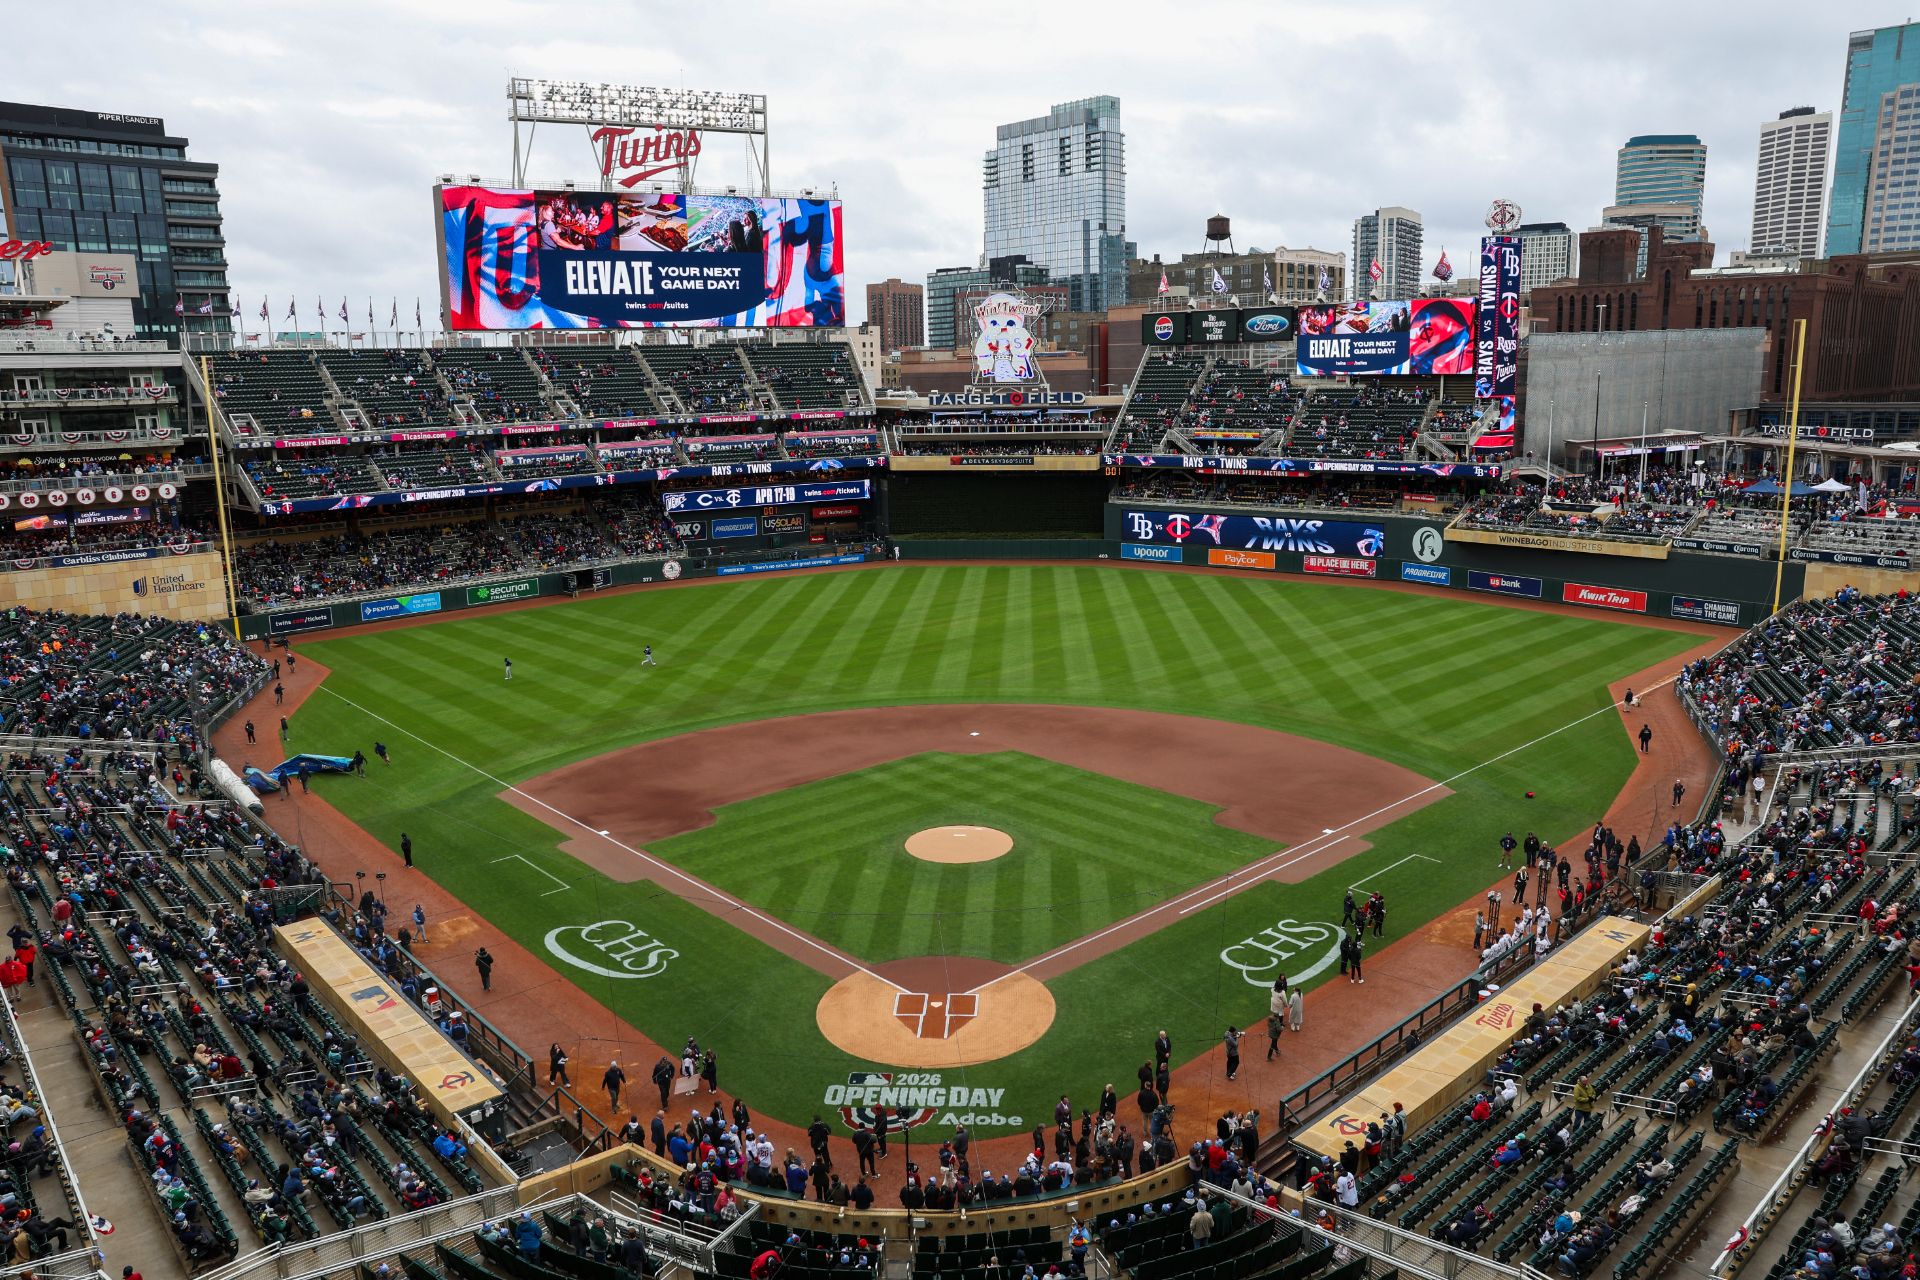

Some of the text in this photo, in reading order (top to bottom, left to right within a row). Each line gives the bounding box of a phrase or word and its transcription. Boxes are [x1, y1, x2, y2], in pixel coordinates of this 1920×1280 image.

[98, 113, 159, 125] PIPER SANDLER
[592, 124, 702, 178] Twins
[1502, 247, 1519, 277] TB
[658, 267, 741, 277] YOUR NEXT
[565, 260, 655, 296] ELEVATE
[661, 280, 740, 290] GAME DAY!
[1481, 265, 1497, 311] TWINS
[625, 302, 689, 310] twins.com/suites
[975, 301, 1039, 317] Win! Twins!
[1202, 320, 1226, 328] Minnesota
[1254, 319, 1279, 332] Ford
[1309, 339, 1350, 358] ELEVATE
[1478, 340, 1494, 375] RAYS
[1496, 363, 1516, 380] Twins
[929, 392, 1085, 405] TARGET FIELD
[507, 425, 554, 434] Treasure Island
[1830, 427, 1873, 438] FIELD
[318, 438, 340, 446] Island
[851, 435, 869, 443] Deck
[653, 445, 671, 454] Deck
[34, 456, 65, 465] Surfside
[1183, 457, 1203, 468] RAYS
[1220, 458, 1247, 469] TWINS
[711, 465, 731, 476] RAYS
[747, 463, 771, 474] TWINS
[1324, 463, 1374, 472] OPENING DAY 2026
[111, 491, 116, 499] 6
[415, 492, 440, 501] OPENING
[440, 490, 452, 499] DAY
[452, 488, 465, 497] 2026
[755, 489, 772, 504] APR
[804, 486, 860, 497] twins.com/tickets
[24, 496, 35, 504] 28
[264, 504, 277, 515] TB
[693, 523, 701, 534] 9
[715, 524, 754, 532] PROGRESSIVE
[1128, 512, 1153, 540] TB
[1252, 517, 1323, 534] RAYS
[1499, 536, 1603, 551] WINNEBAGO INDUSTRIES
[1673, 538, 1697, 548] Corona
[1702, 541, 1727, 551] Corona
[1134, 547, 1168, 558] uponor
[1733, 544, 1759, 554] Corona
[1792, 549, 1819, 559] Corona
[63, 551, 147, 565] Carbliss Clubhouse
[1224, 554, 1257, 565] Paycor
[1834, 553, 1862, 563] Corona
[1877, 557, 1907, 567] Corona
[1317, 558, 1339, 567] PLACE
[1351, 561, 1369, 570] HERE
[152, 574, 184, 584] United
[1405, 567, 1448, 580] PROGRESSIVE
[153, 580, 205, 594] Healthcare
[490, 582, 529, 595] securian
[490, 592, 518, 600] FINANCIAL
[372, 604, 399, 612] PENTAIR
[1704, 603, 1737, 613] CHANGING
[275, 614, 327, 627] twins.com/tickets
[1704, 610, 1736, 621] THE GAME
[579, 919, 680, 975] CHS
[1219, 917, 1332, 976] CHS
[896, 1073, 941, 1086] 2026
[824, 1085, 1005, 1107] OPENING DAY
[938, 1112, 1023, 1126] Adobe
